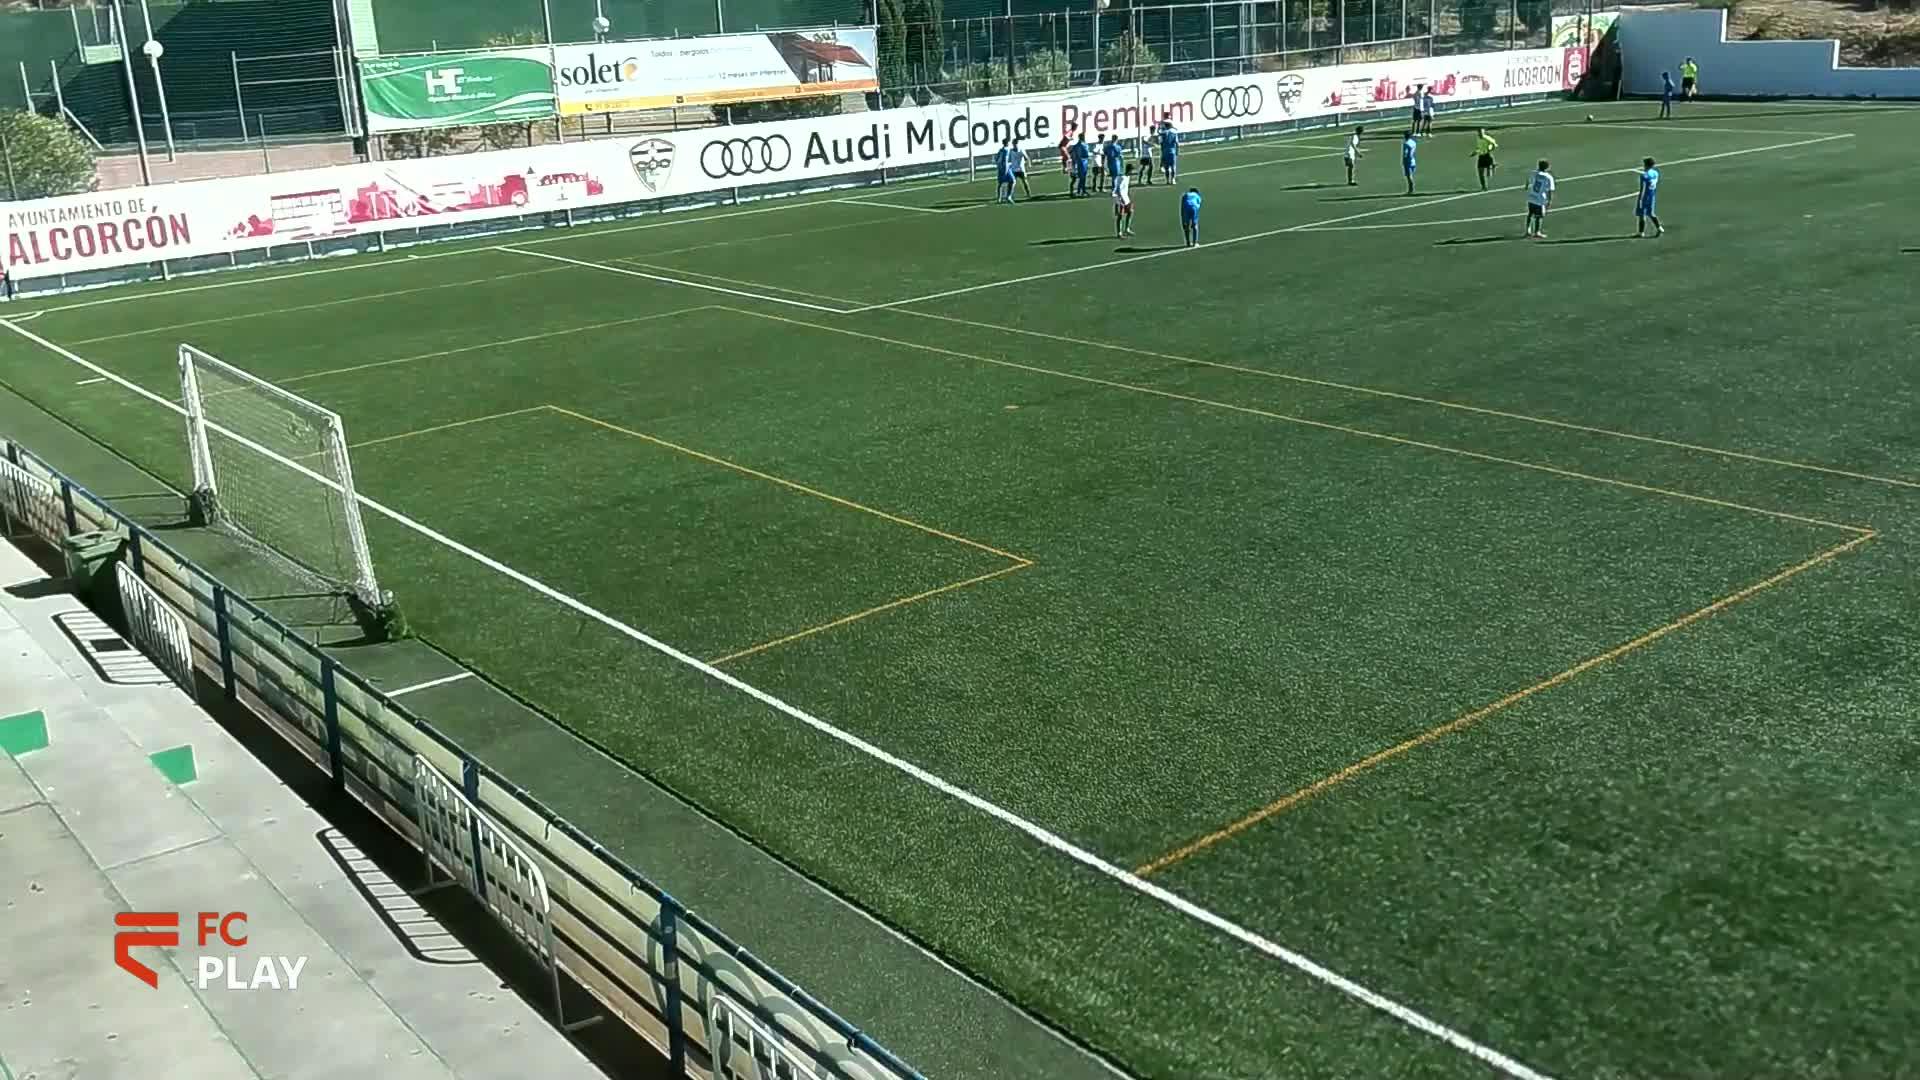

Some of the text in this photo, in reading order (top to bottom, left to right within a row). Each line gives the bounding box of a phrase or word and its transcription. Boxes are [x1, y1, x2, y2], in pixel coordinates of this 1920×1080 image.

[804, 124, 891, 168] Audi
[1061, 100, 1194, 136] Premium
[9, 198, 147, 228] AYUNTAMIENTO DE
[9, 206, 191, 266] ALCORCÓN
